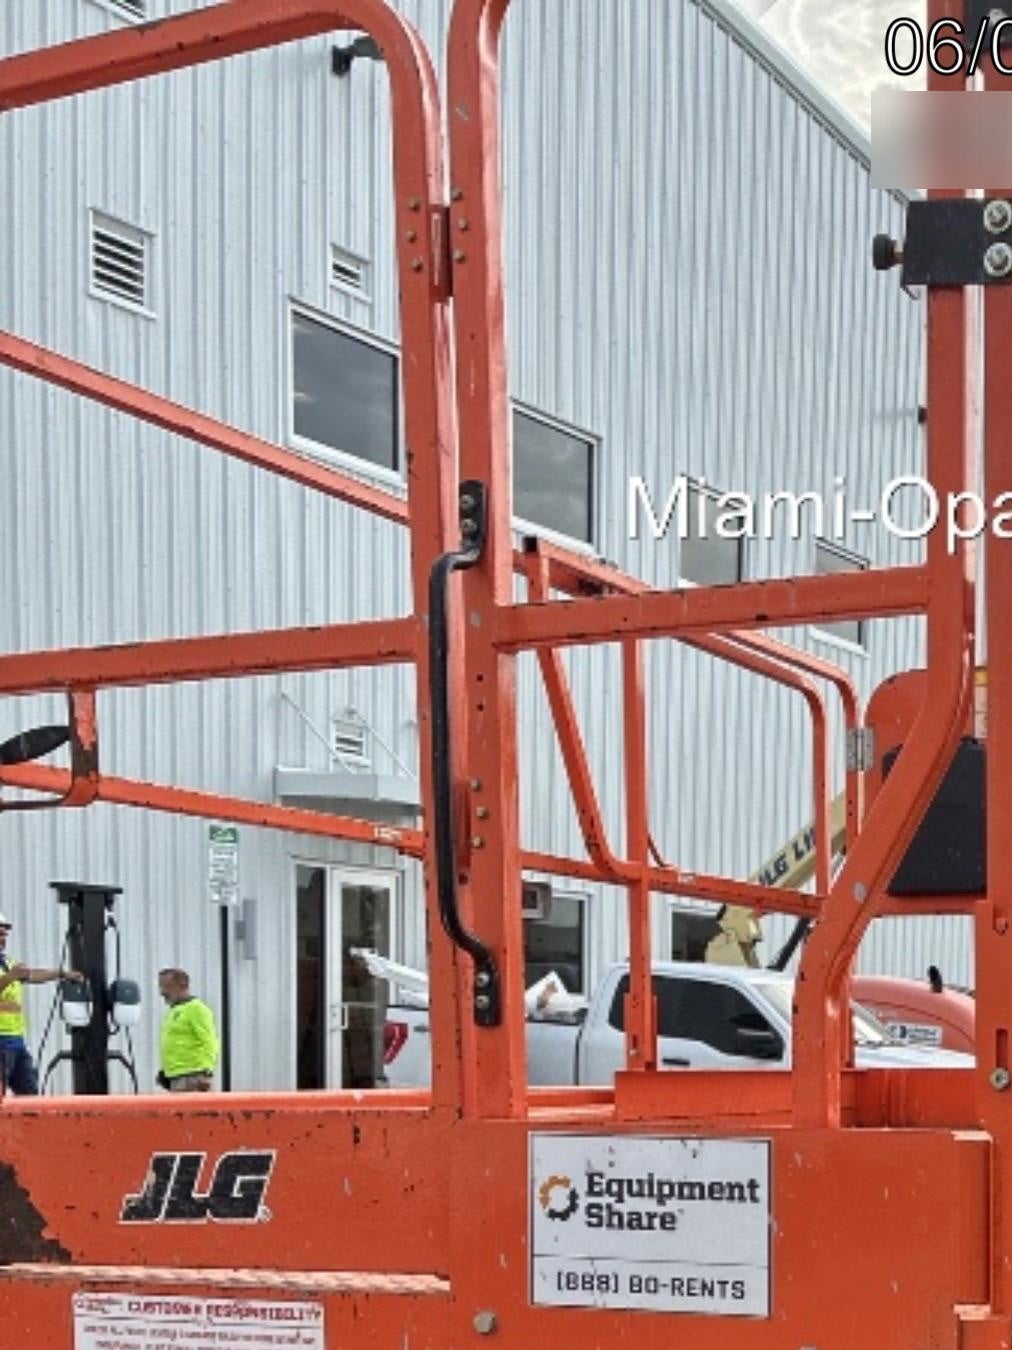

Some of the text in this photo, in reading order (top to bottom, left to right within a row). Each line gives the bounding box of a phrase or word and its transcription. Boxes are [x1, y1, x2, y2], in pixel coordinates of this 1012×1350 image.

[117, 1149, 277, 1225] JLG
[585, 1171, 760, 1206] Equipment
[584, 1203, 677, 1231] Share
